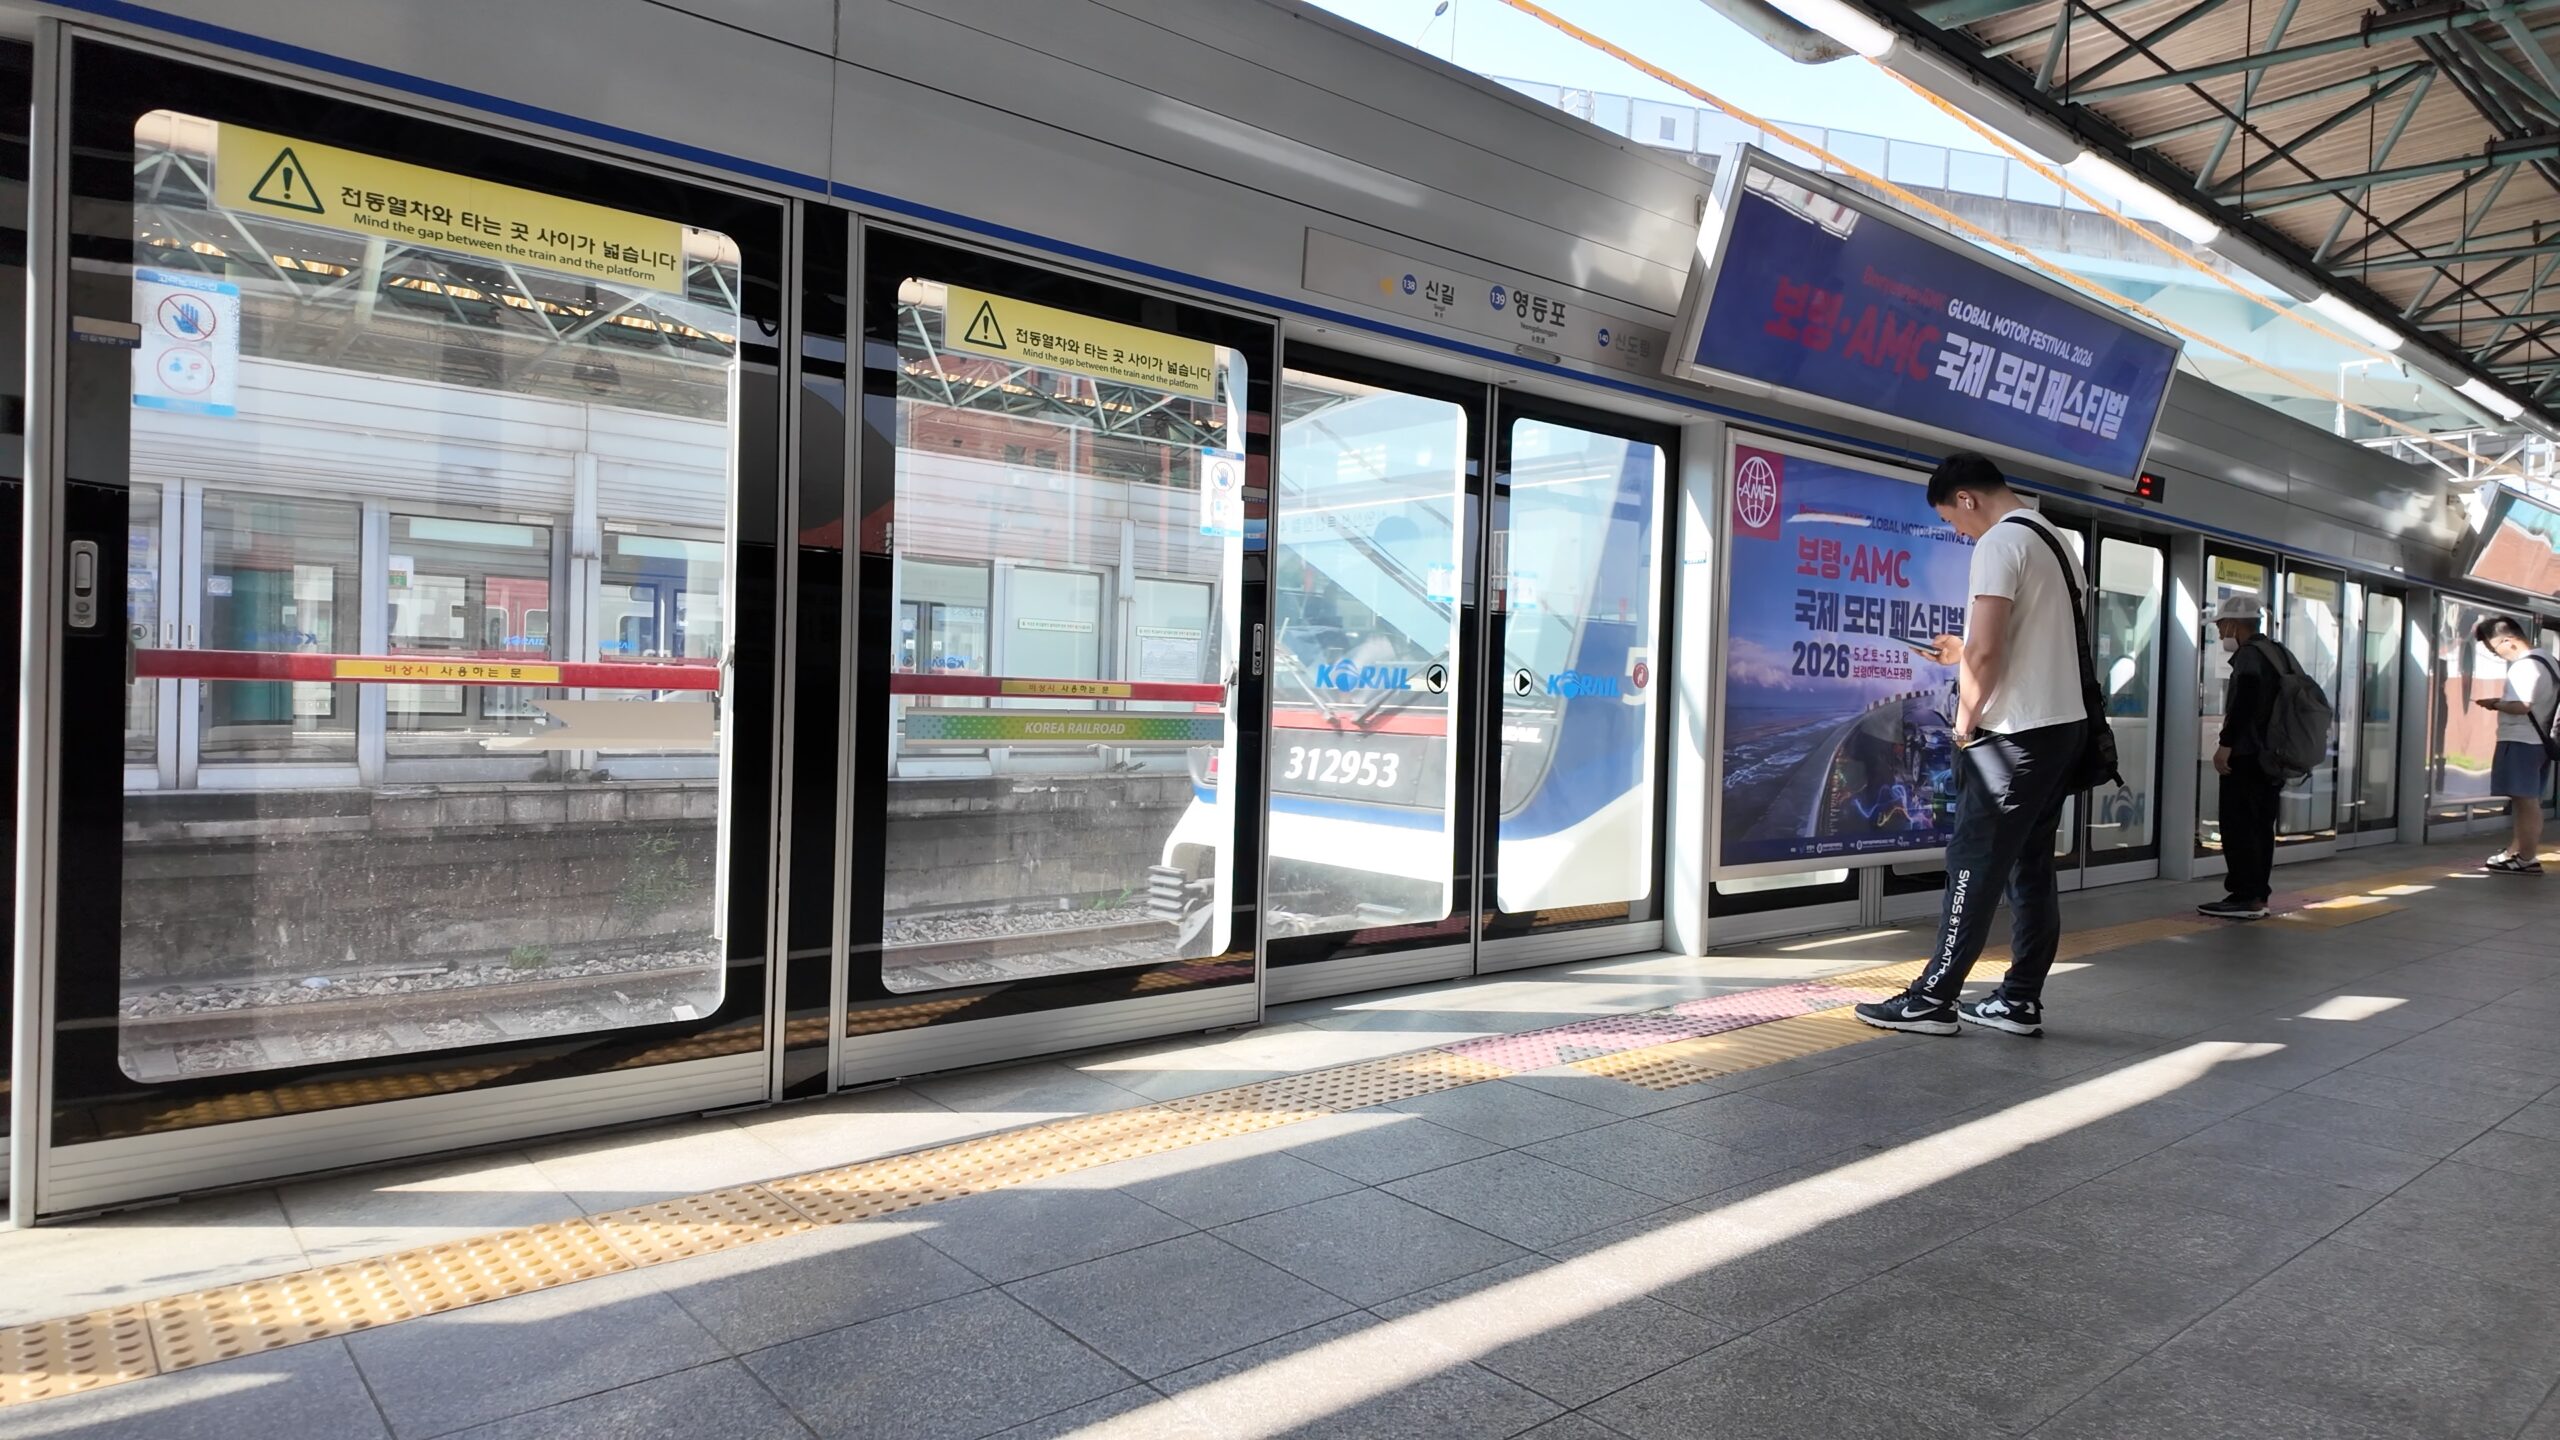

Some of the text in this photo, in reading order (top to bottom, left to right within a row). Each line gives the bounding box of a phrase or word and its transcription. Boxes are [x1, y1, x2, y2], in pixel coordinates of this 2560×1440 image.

[341, 186, 676, 271] 전동열차와 타는 곳 사이가 넓습니다
[353, 213, 655, 281] Mind the gap between the train and the platform
[1403, 279, 1415, 291] 138
[1425, 280, 1454, 306] 신길
[1491, 292, 1506, 305] 139
[1513, 290, 1566, 327] 영등포
[1948, 298, 2093, 367] GLOBAL MOTOR FESTIVAL 2026
[1016, 328, 1211, 382] 전동열차와 타는 곳 사이가 넓습니다
[1023, 347, 1198, 390] Mind the gap between the train and the platform
[1935, 332, 2129, 440] 국제 모터 페스티벌
[1796, 536, 1912, 588] 보령·AMC
[1795, 588, 1965, 640] 국제 모터 페스티벌
[384, 664, 522, 679] 비상시 사용하는 문
[1316, 658, 1411, 693] KORAIL
[1792, 641, 1850, 679] 2026
[1061, 685, 1096, 694] 사용하는
[1546, 670, 1621, 699] KORAIL
[1025, 721, 1126, 735] KOREA RAILROAD
[1284, 746, 1400, 788] 312953
[1951, 869, 1970, 914] SWISS
